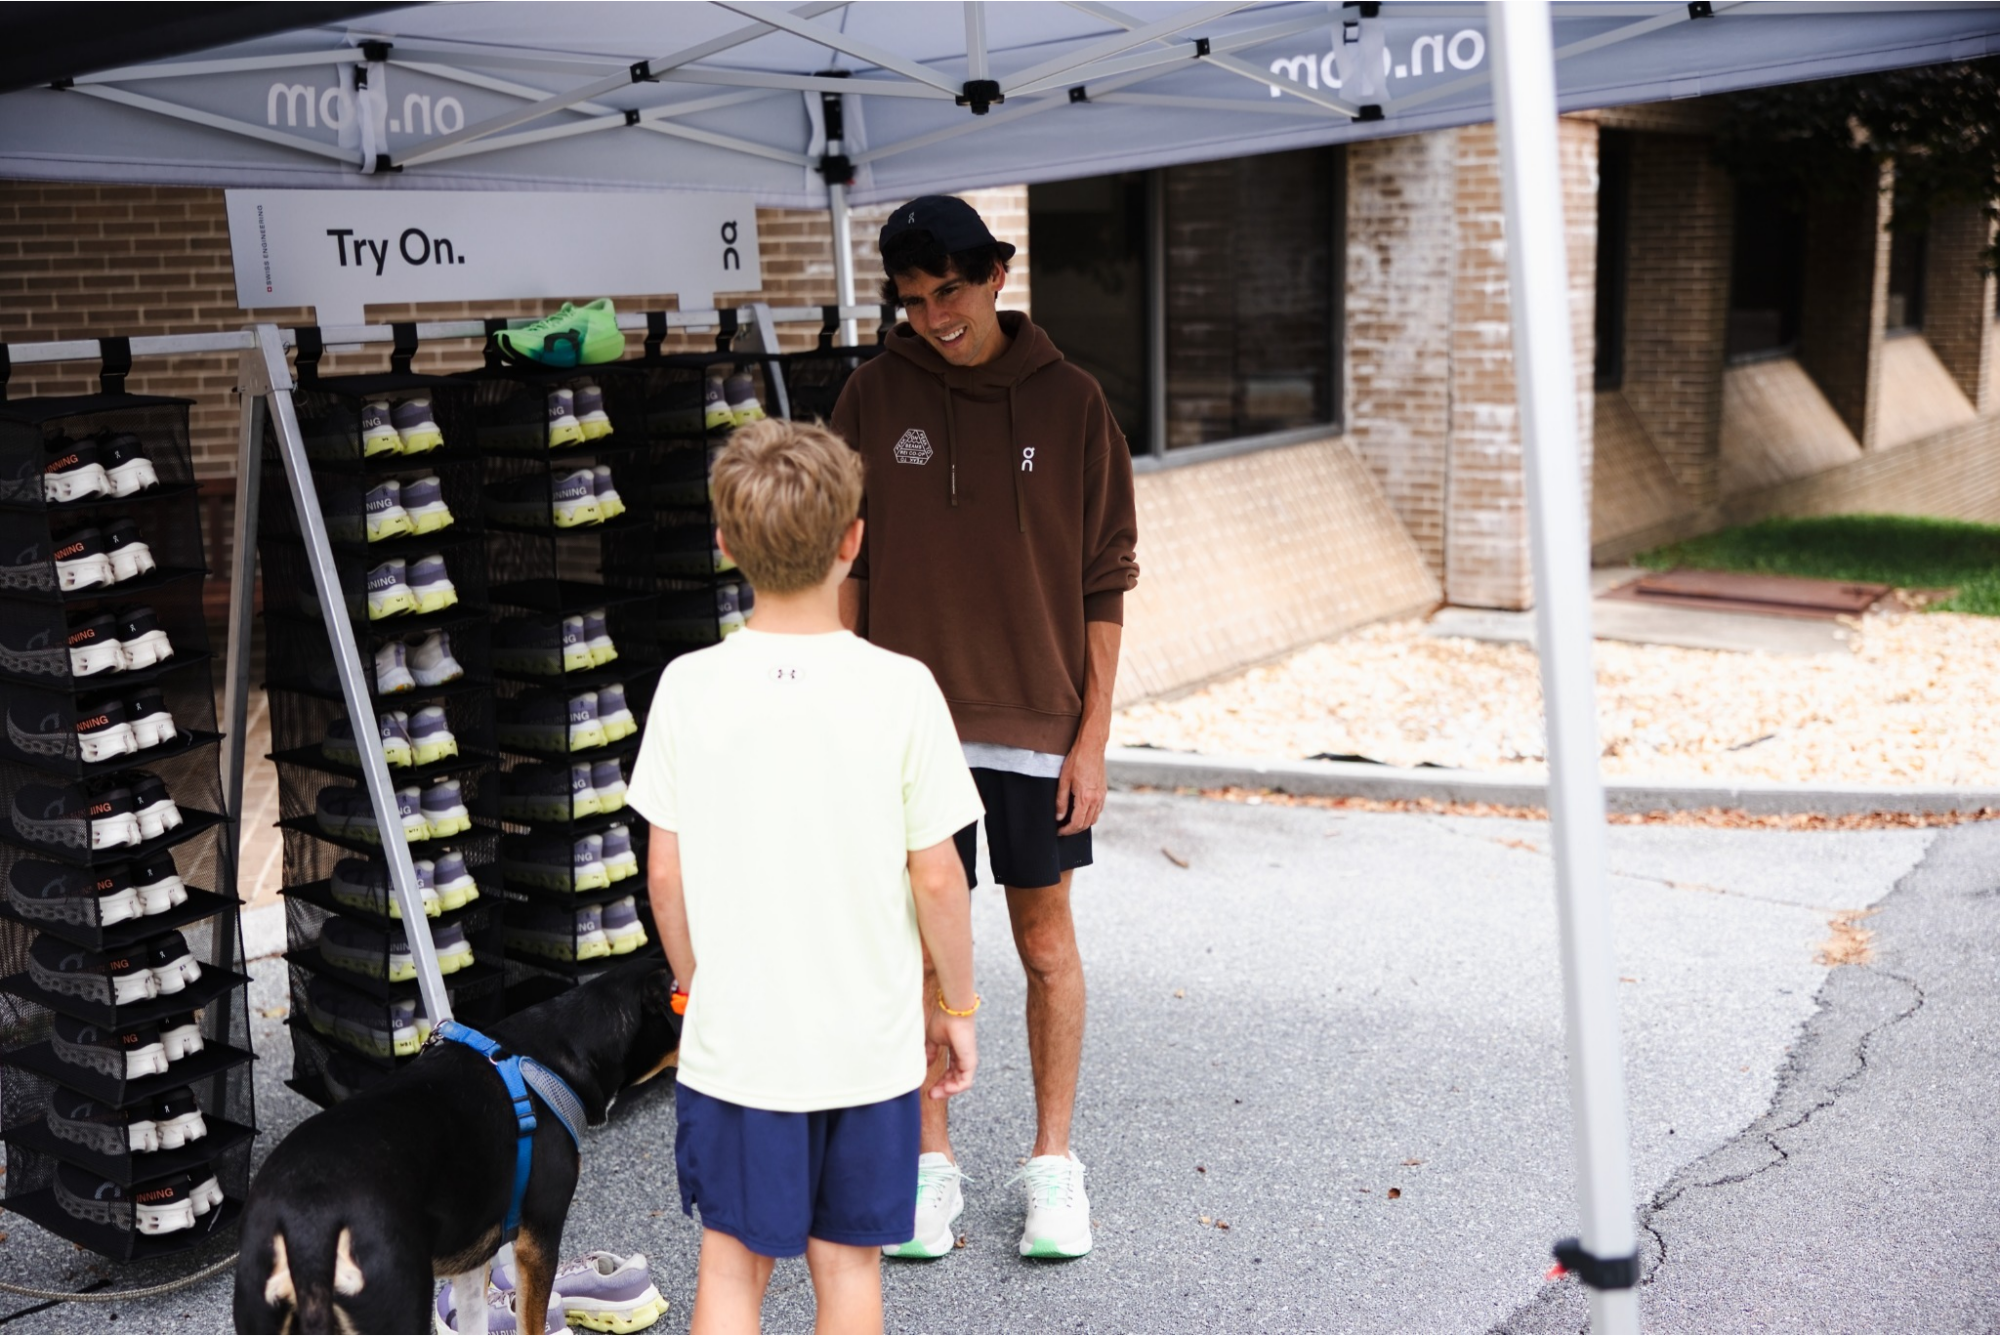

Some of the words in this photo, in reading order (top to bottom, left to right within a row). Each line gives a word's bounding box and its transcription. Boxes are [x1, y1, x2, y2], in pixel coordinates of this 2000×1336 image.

[257, 204, 269, 260] ENGINEERING
[326, 228, 389, 276] Try
[399, 227, 465, 266] On.
[263, 260, 272, 286] SWISS
